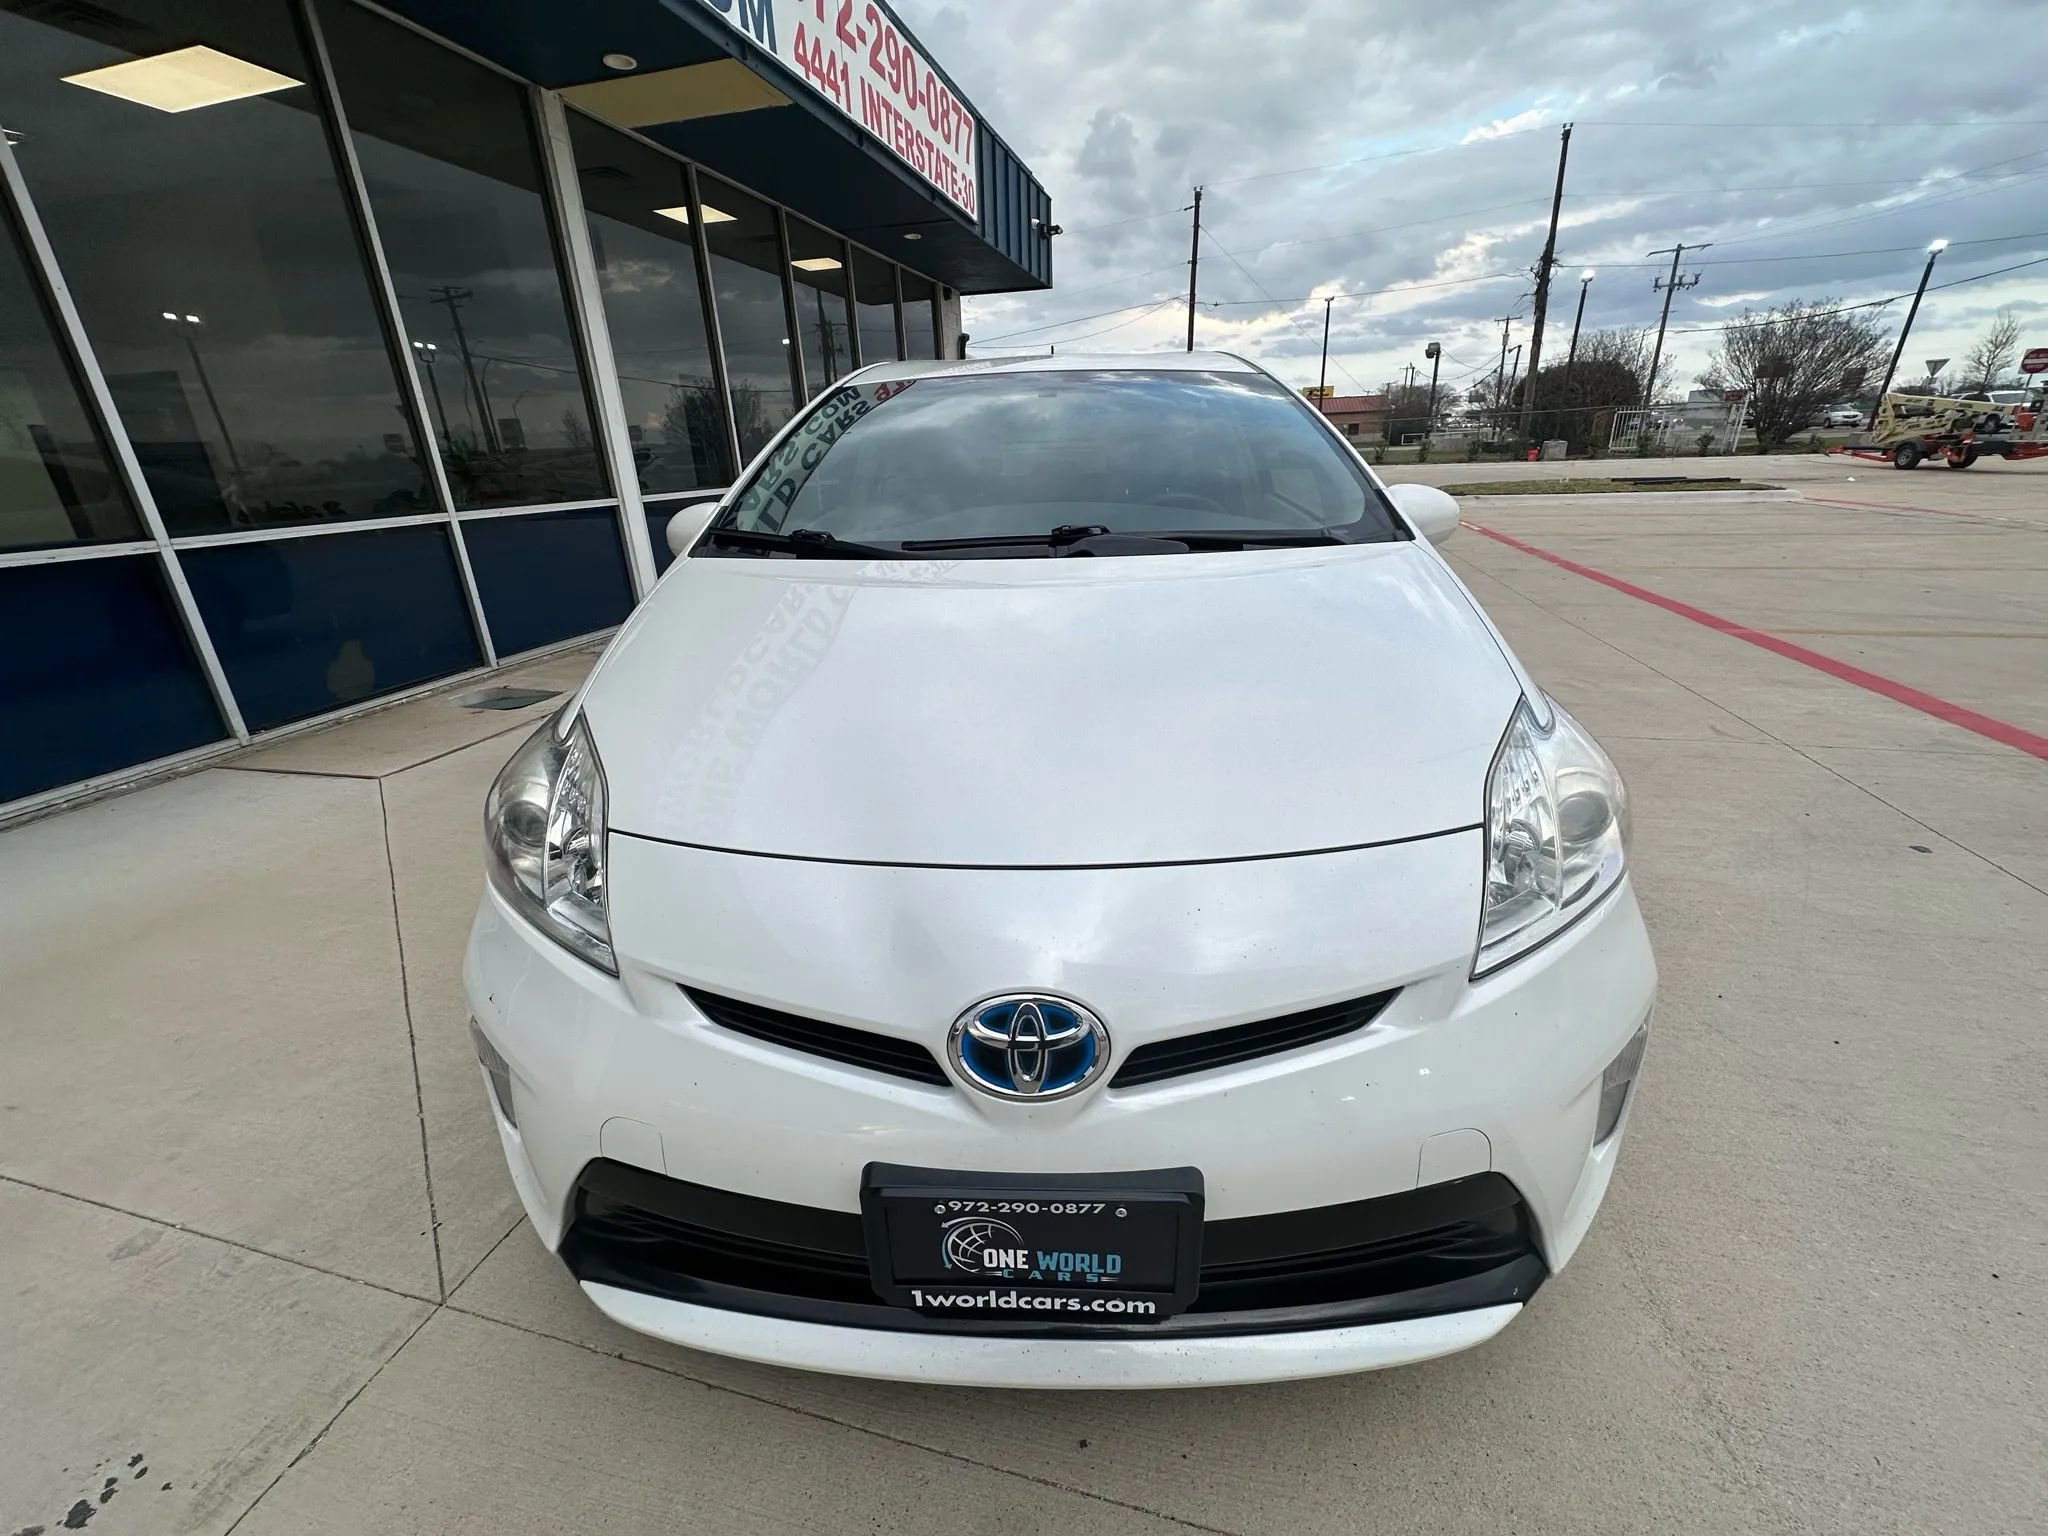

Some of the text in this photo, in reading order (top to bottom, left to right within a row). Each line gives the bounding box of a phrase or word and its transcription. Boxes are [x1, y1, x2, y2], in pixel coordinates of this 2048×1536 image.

[798, 0, 973, 164] 2-290-0877
[793, 21, 975, 215] 4441 INTERSTATE-30
[947, 1199, 1107, 1216] 972-290-0877
[983, 1248, 1122, 1275] ONE WORLD
[1003, 1269, 1100, 1282] CARS
[911, 1289, 1156, 1315] 1worldcars.com
